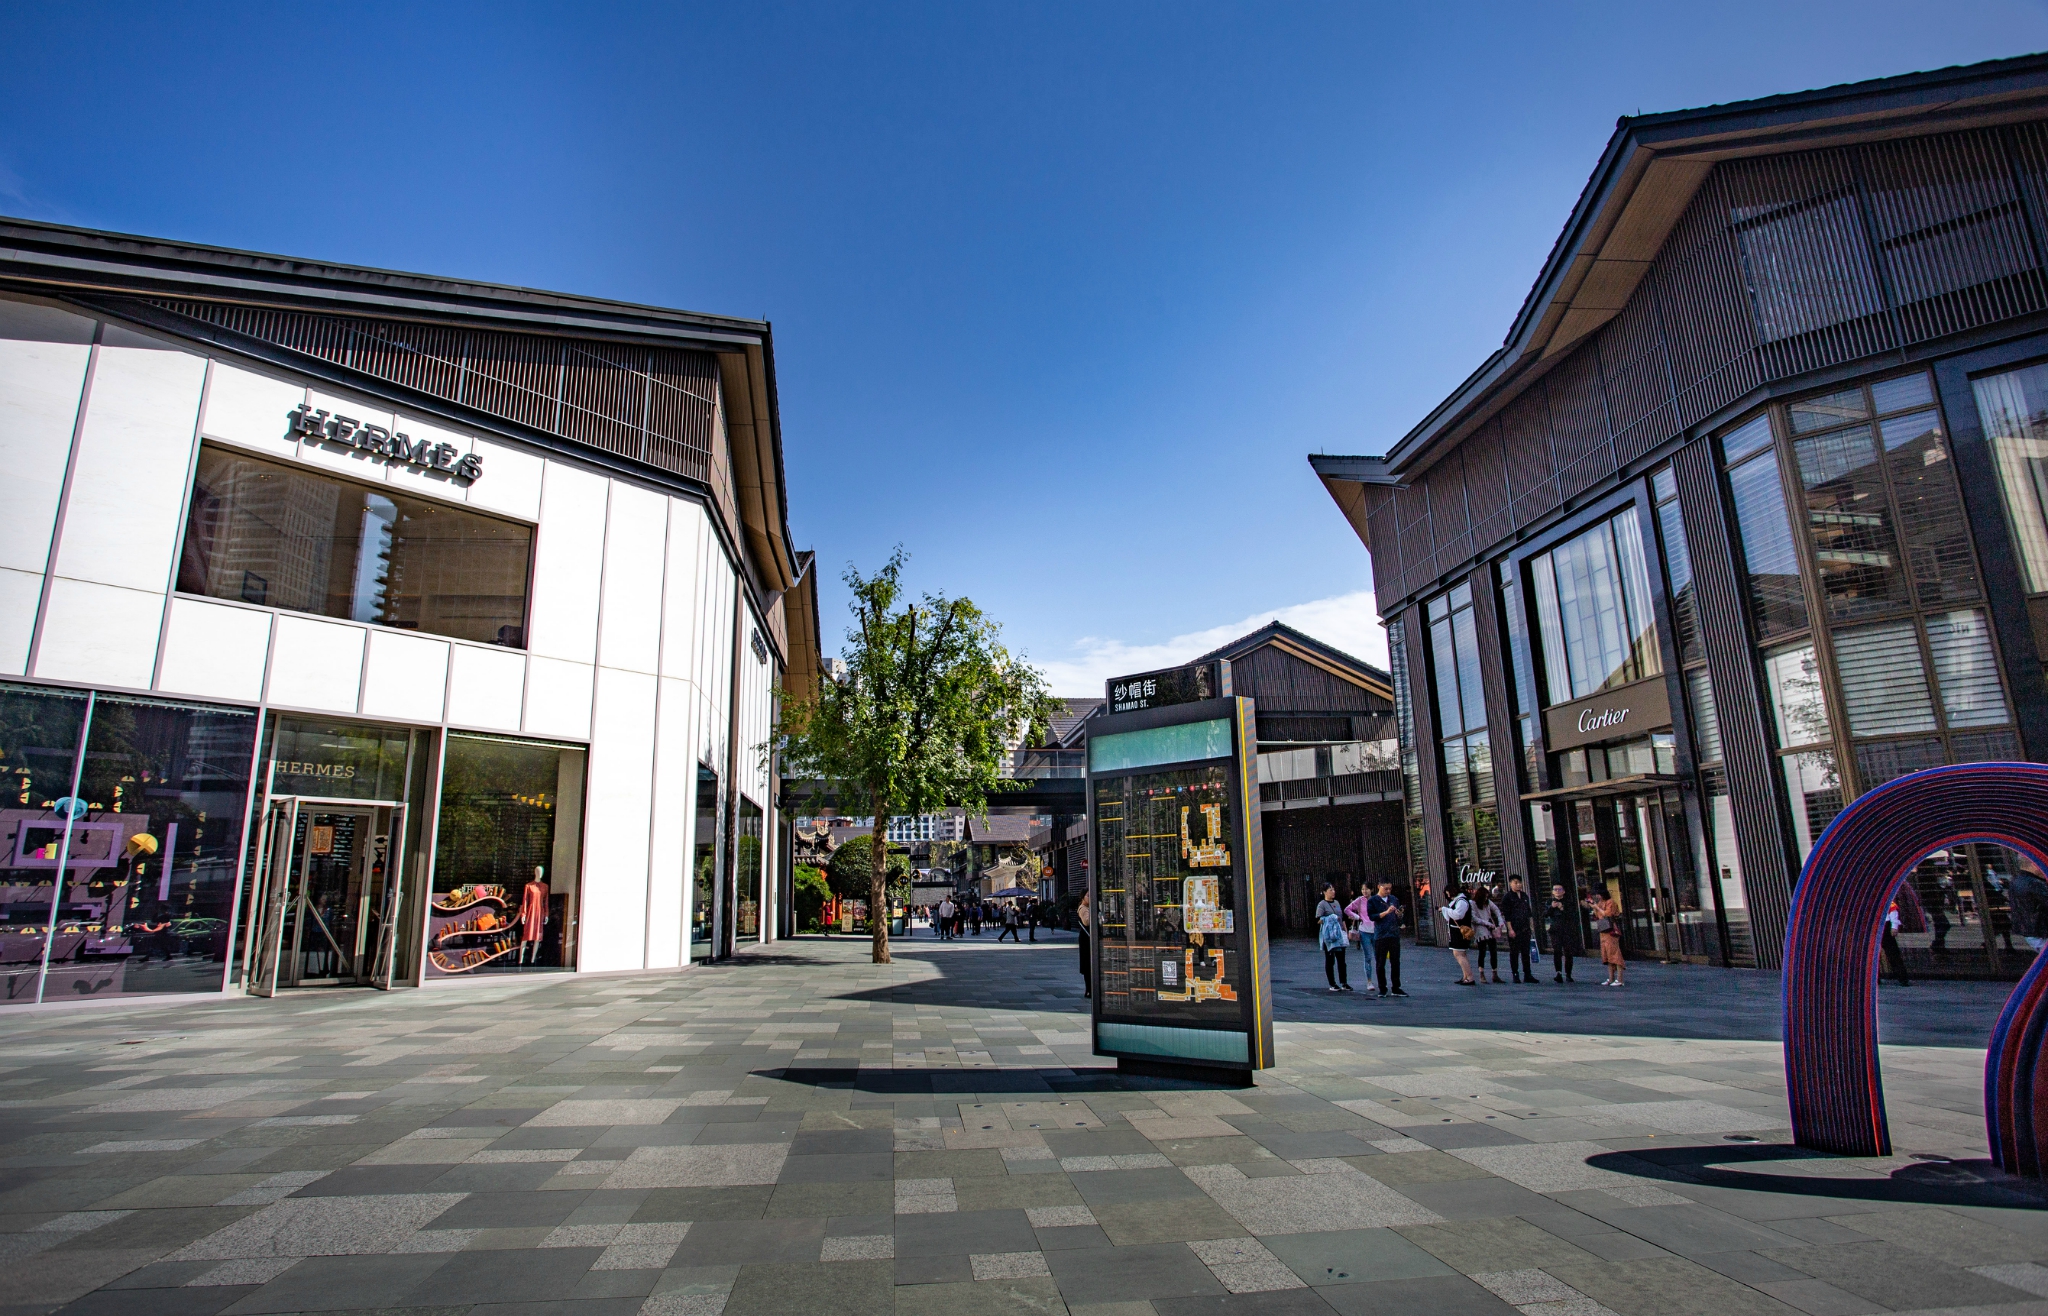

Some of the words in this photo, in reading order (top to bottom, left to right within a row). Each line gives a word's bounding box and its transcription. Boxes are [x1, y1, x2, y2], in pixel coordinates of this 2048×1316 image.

[1114, 679, 1157, 701] 纱帽街
[1114, 700, 1139, 712] SHAMAO
[1139, 699, 1149, 708] ST.
[1578, 708, 1630, 733] Cartier
[1460, 863, 1496, 883] Cartier
